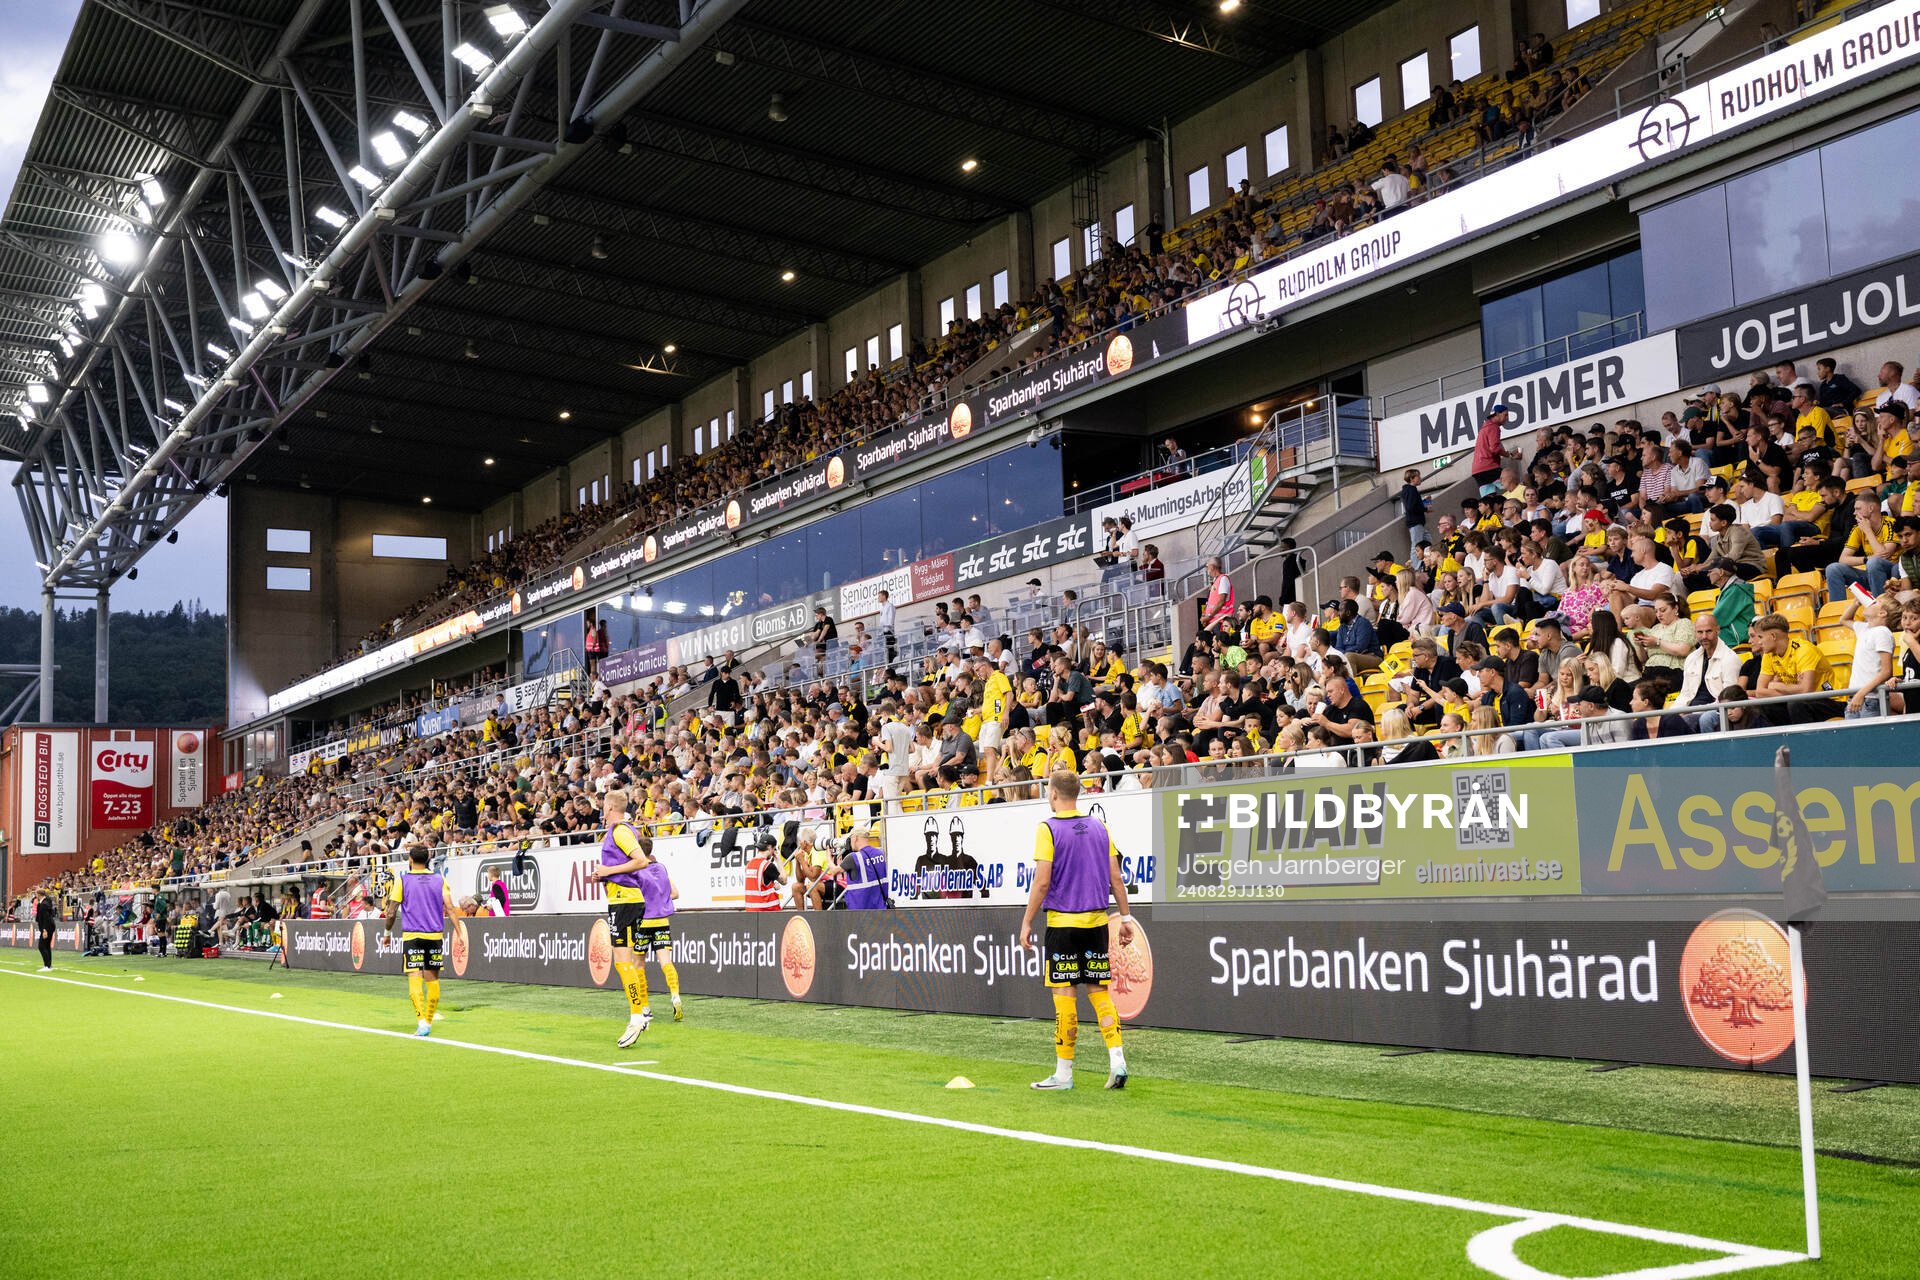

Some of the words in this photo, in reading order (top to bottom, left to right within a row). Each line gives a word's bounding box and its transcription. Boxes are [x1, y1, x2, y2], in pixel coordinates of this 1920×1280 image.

[1722, 48, 1834, 121] RUDHOLM
[1278, 251, 1346, 301] RUDHOLM
[1350, 230, 1401, 271] GROUP
[989, 378, 1051, 416] Sparbanken
[1052, 353, 1104, 393] Sjuhärad
[1420, 355, 1626, 454] MAKSIMER
[857, 438, 907, 471] Sparbanken
[908, 417, 949, 452] Sjuhärad
[751, 486, 792, 514] Sparbanken
[792, 469, 826, 496] Sjuhärad
[957, 554, 984, 583] stc
[989, 544, 1017, 573] stc
[1022, 534, 1052, 564] stc
[1056, 523, 1088, 555] stc
[841, 572, 911, 606] Seniorarbeten
[679, 624, 745, 659] VINNERGI
[755, 616, 789, 638] Bloms
[789, 607, 805, 627] AB
[605, 664, 632, 682] amicus
[638, 654, 667, 673] amicus
[39, 737, 48, 756] BIL
[38, 757, 48, 818] BOGSTEDT
[56, 752, 65, 829] www.bogstedtbil.se
[103, 800, 142, 815] 7-23
[1607, 773, 1920, 873] Assem
[865, 854, 885, 867] FOTO
[1134, 855, 1157, 884] AB
[1415, 857, 1563, 885] elmanivast.se
[710, 875, 744, 888] BETON
[891, 865, 974, 898] Bygg-bröderna
[294, 931, 326, 955] Sparbanken
[325, 931, 351, 957] Sjuhärad
[483, 931, 537, 963] Sparbanken
[538, 931, 585, 966] Sjuhärad
[709, 931, 776, 976] Sjuhärad
[847, 933, 966, 979] Sparbanken
[972, 933, 1046, 986] Sjuhä
[1209, 935, 1430, 997] Sparbanken
[1442, 937, 1659, 1010] Sjuhärad
